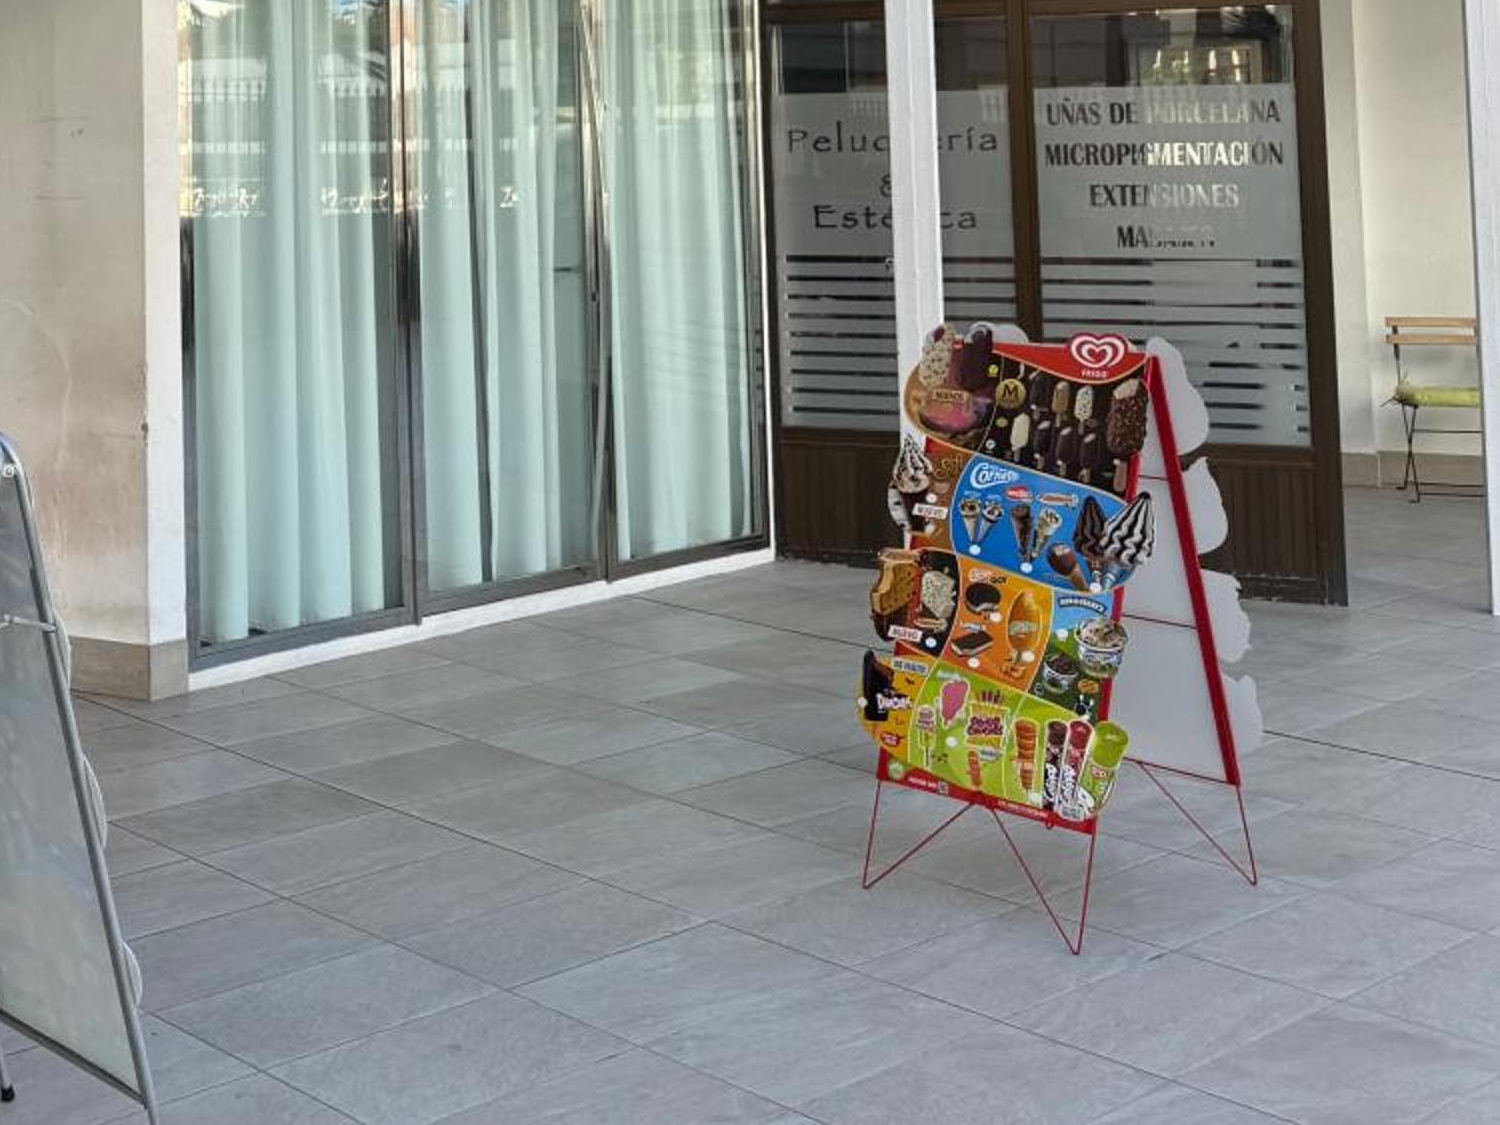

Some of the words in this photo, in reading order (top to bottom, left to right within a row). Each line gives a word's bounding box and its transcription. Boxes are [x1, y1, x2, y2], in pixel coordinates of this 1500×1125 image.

[1046, 96, 1101, 125] UÑAS
[1109, 102, 1139, 124] DE
[787, 120, 998, 154] Peluría
[1045, 135, 1284, 167] MICROPIGMENTACIÓN
[1090, 183, 1240, 208] EXTENSIONES
[813, 205, 977, 230] Estca
[1002, 385, 1019, 398] M
